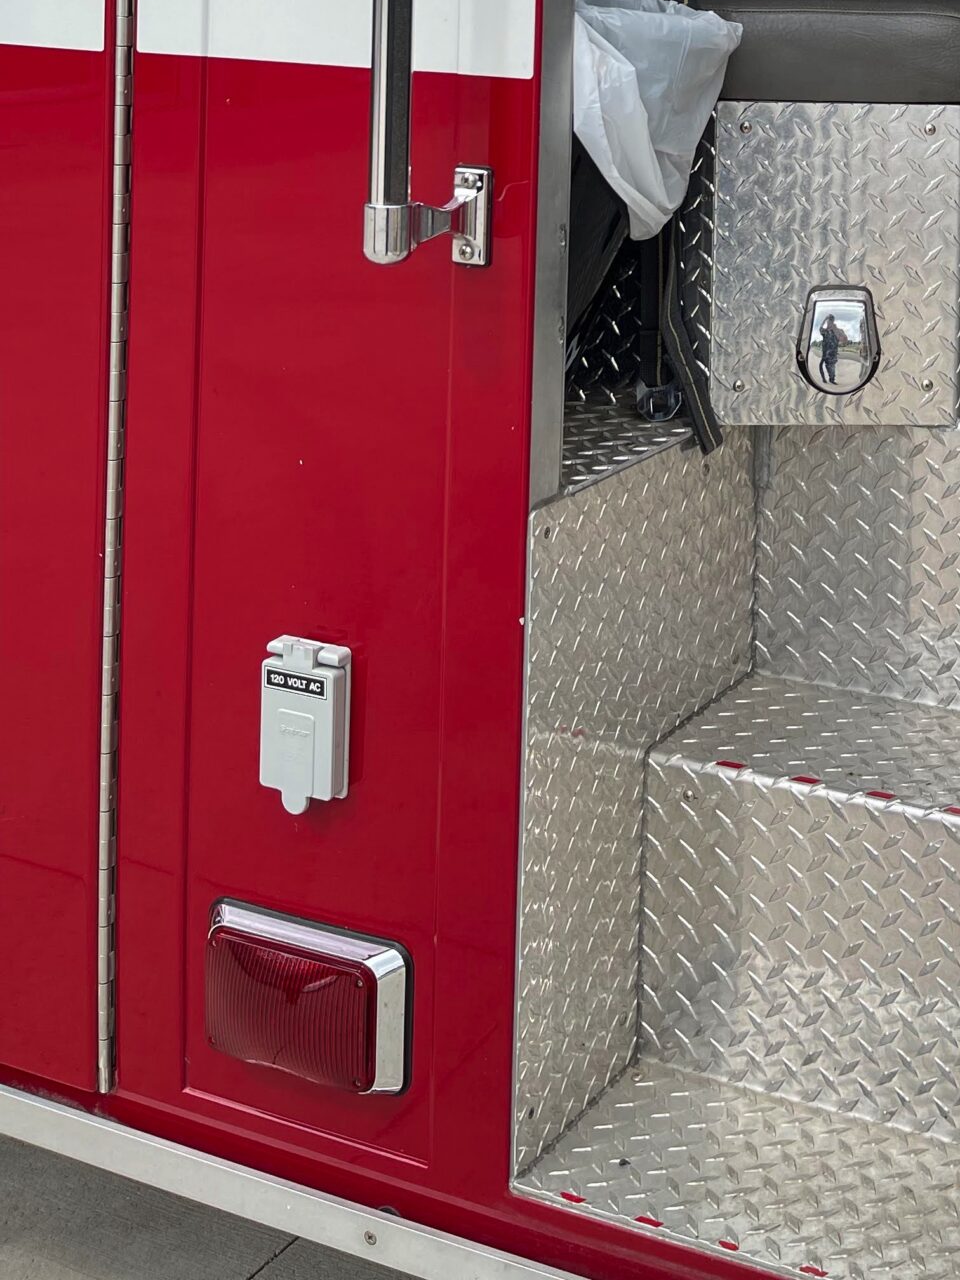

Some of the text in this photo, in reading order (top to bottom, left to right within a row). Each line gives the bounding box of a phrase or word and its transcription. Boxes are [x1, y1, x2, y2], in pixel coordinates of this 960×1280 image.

[269, 674, 321, 692] 120 VOLT AC
